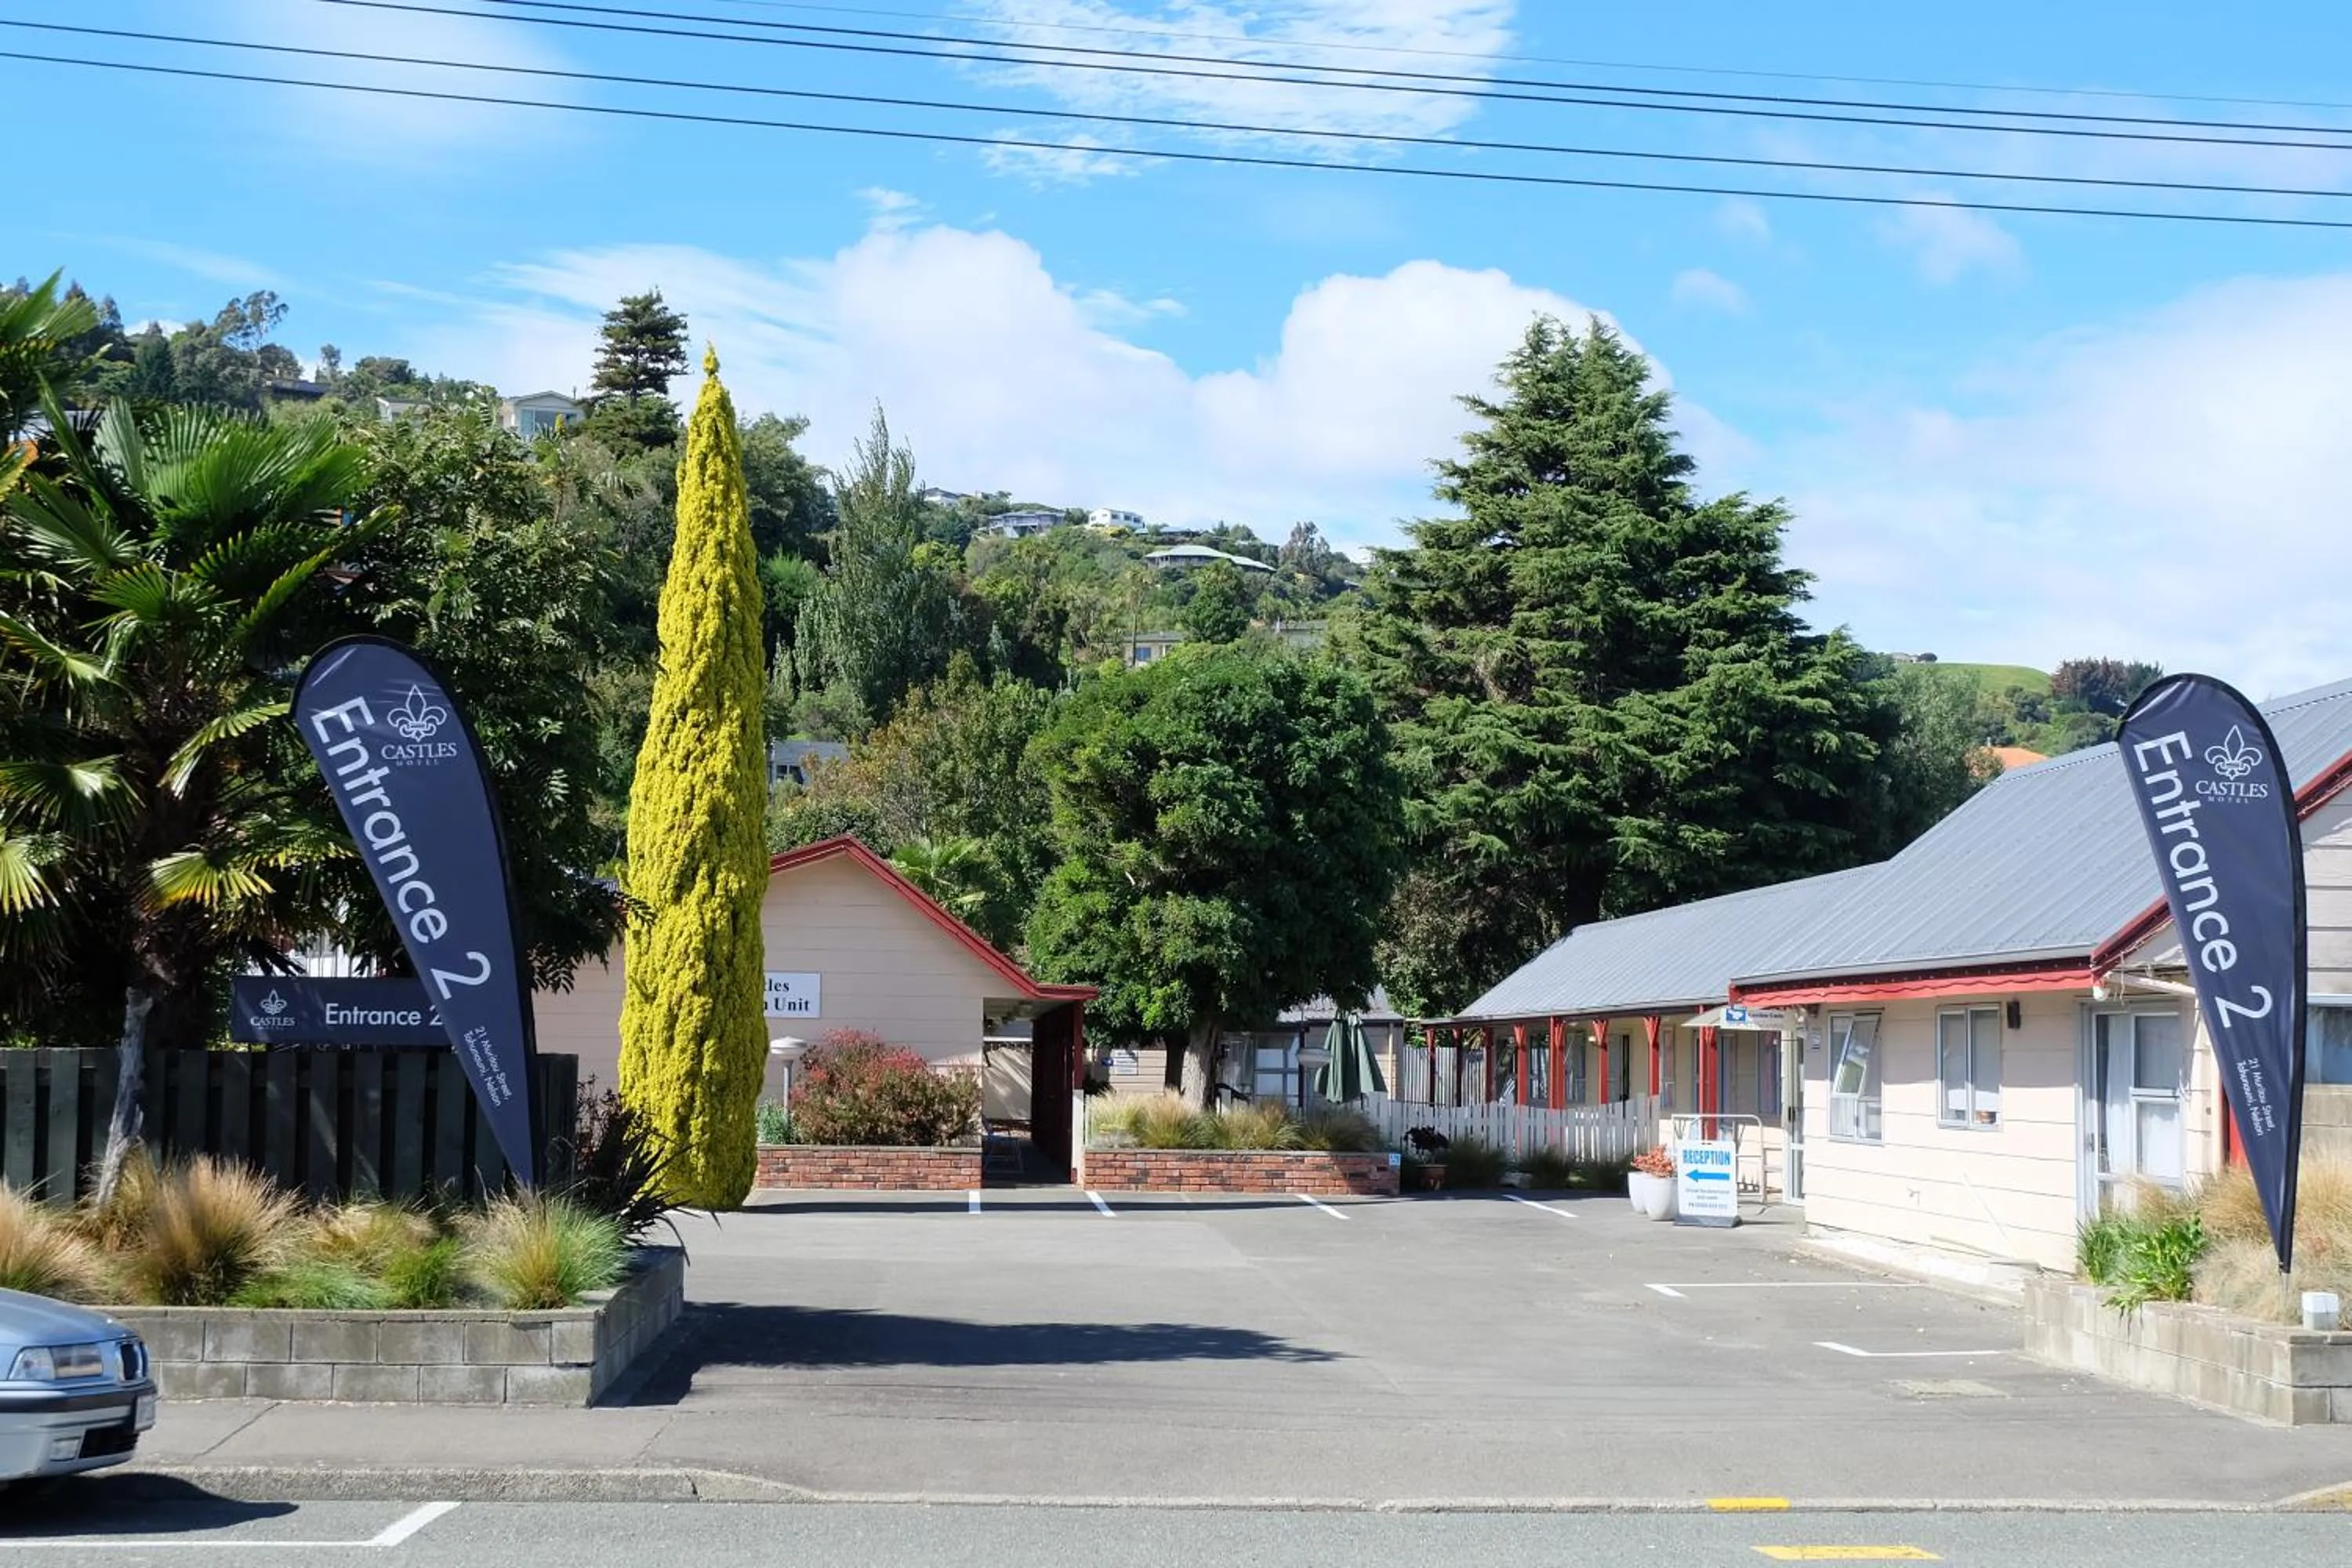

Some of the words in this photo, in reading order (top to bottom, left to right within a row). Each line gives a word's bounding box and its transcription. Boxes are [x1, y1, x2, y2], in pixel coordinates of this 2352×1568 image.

[381, 742, 457, 760] CASTLES
[2195, 780, 2268, 798] CASTLES
[310, 696, 448, 944] Entrance
[430, 951, 492, 1000] 2
[2133, 731, 2238, 972] Entrance
[2215, 985, 2273, 1029] 2
[775, 997, 809, 1011] Unit
[250, 1016, 296, 1026] CASTLES
[325, 1003, 422, 1025] Entrance
[474, 1025, 487, 1039] 21
[2248, 1058, 2261, 1069] 21
[484, 1076, 501, 1106] Nelson
[2249, 1105, 2263, 1136] Nelson
[1682, 1149, 1730, 1166] RECEPTION
